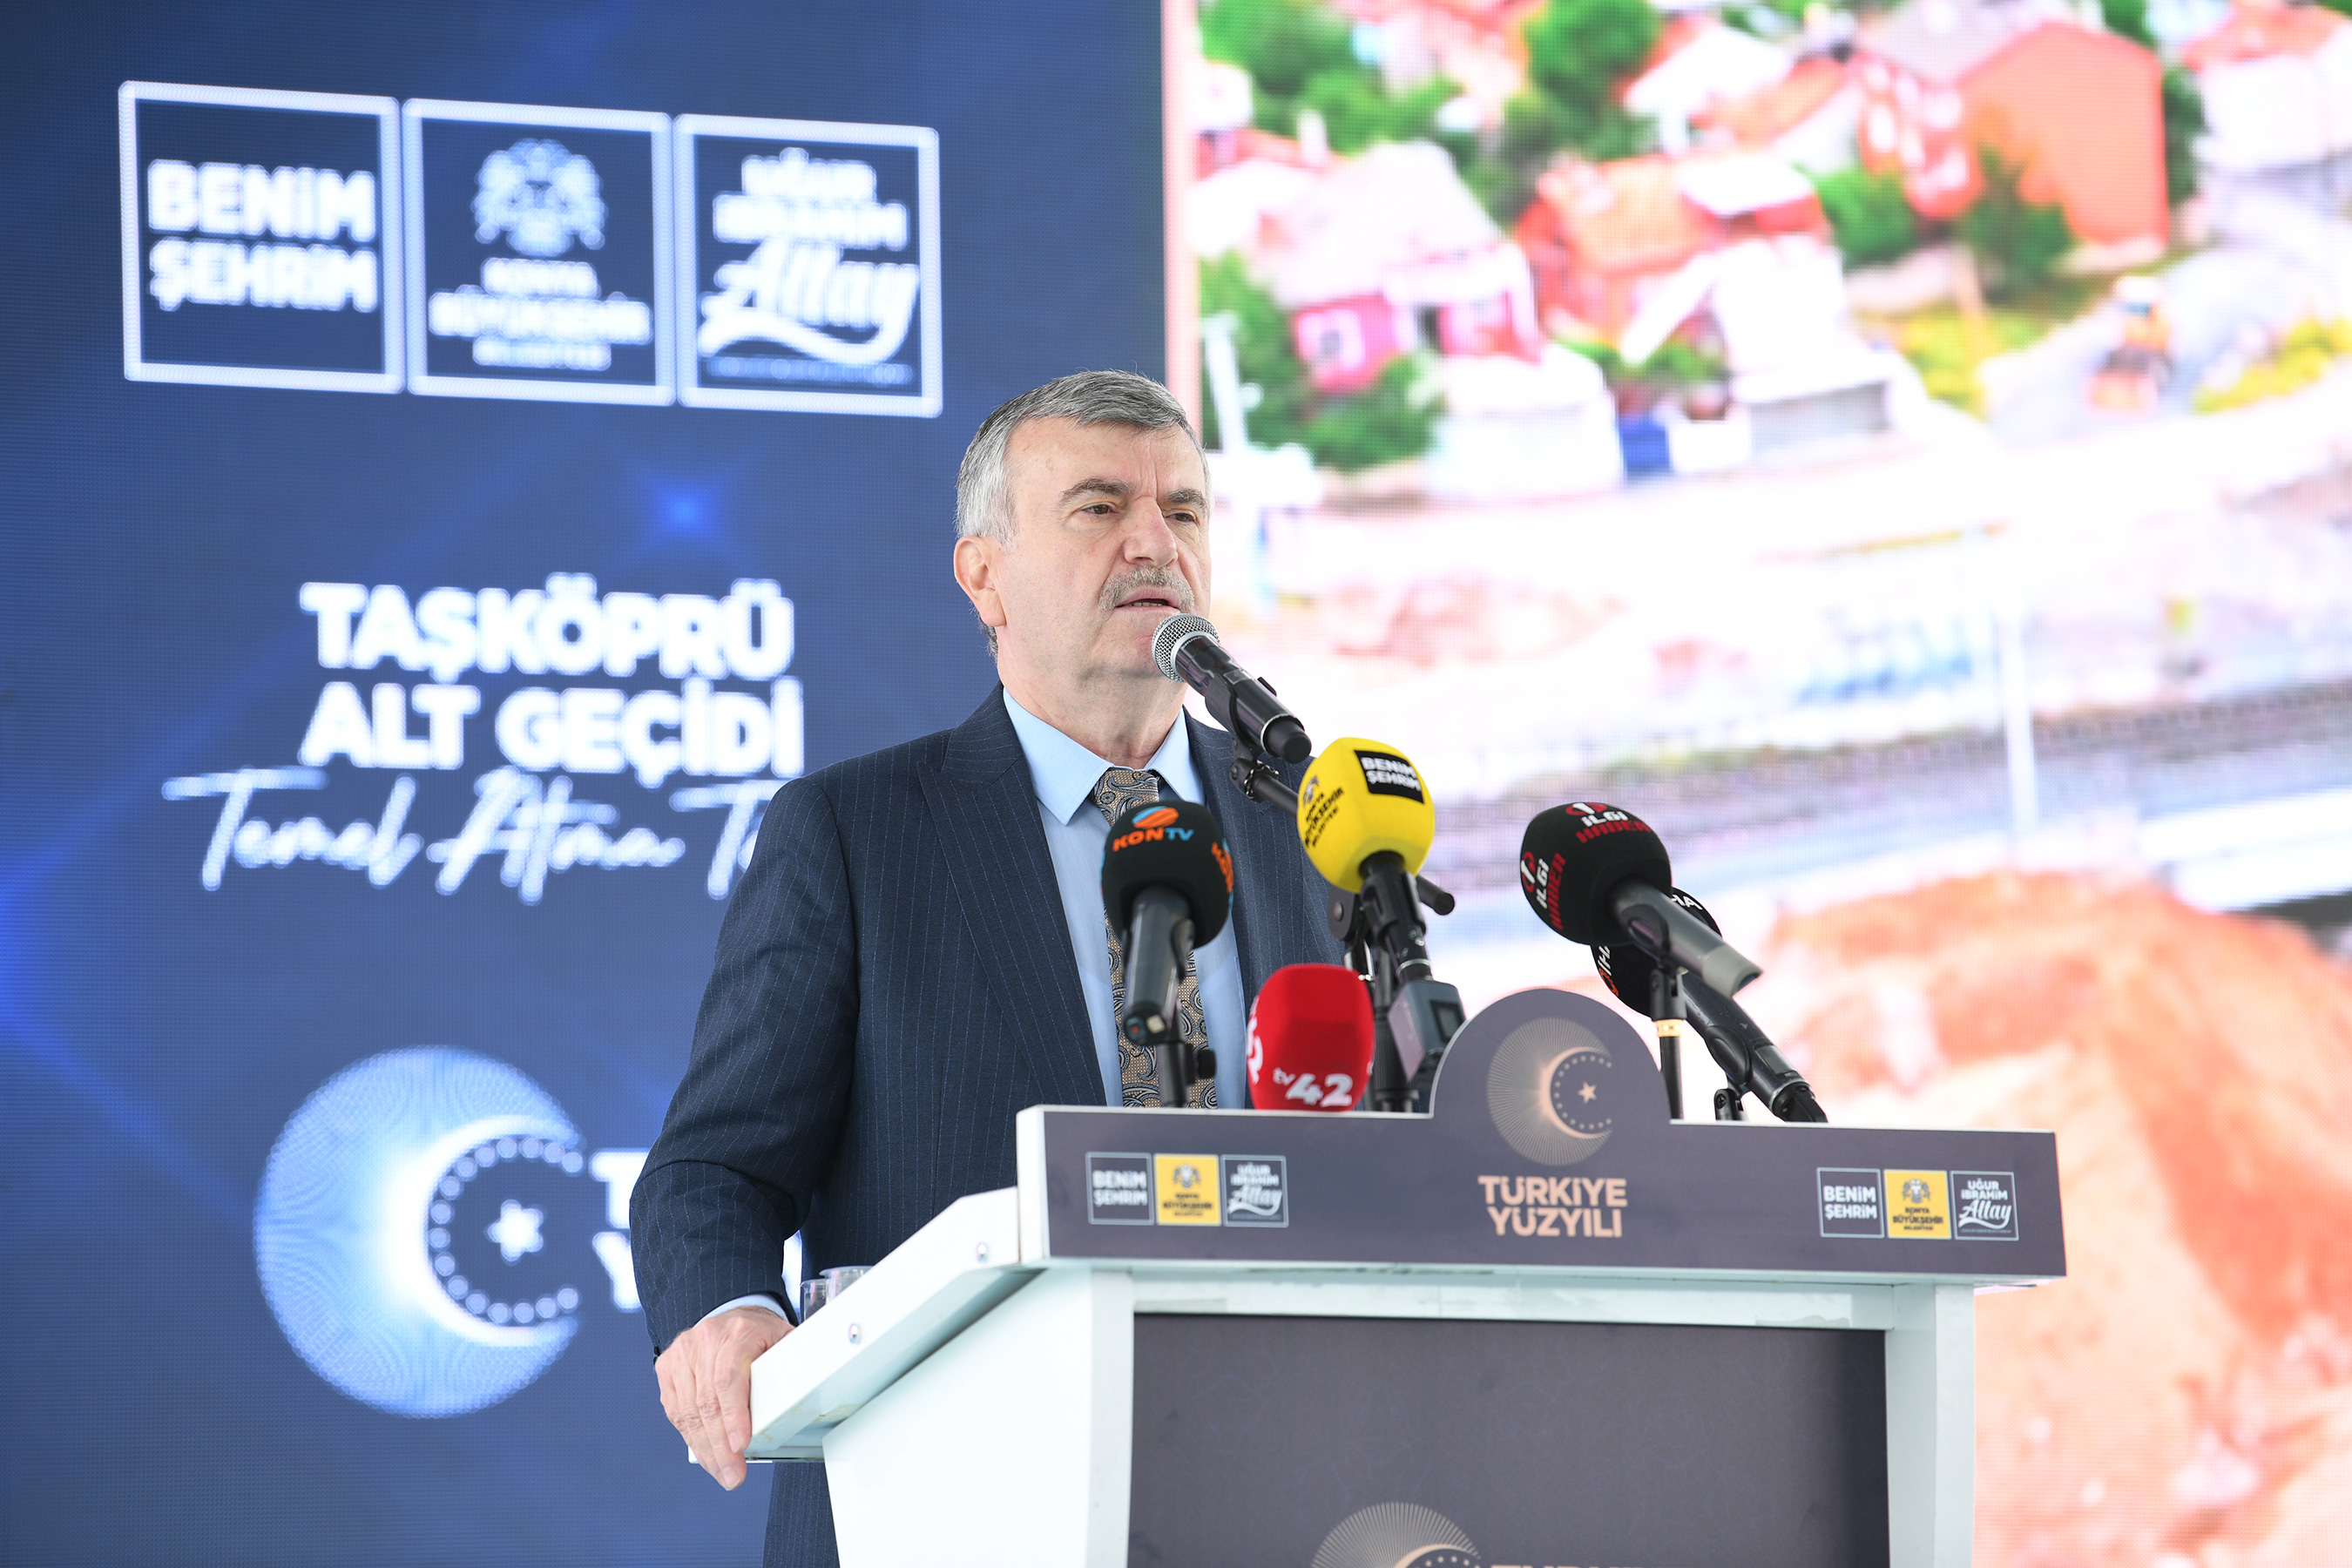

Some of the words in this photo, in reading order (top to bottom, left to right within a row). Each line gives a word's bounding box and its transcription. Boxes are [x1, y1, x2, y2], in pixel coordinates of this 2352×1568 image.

[148, 159, 375, 241] BENİM
[150, 237, 377, 312] ŞEHRİM
[300, 571, 795, 683] TAŞKÖPRÜ
[298, 680, 481, 770] ALT
[495, 676, 805, 788] GEÇİDİ
[162, 766, 423, 892] Temel
[427, 766, 686, 906] Atma
[1477, 1175, 1628, 1207] TÜRKİYE
[1823, 1186, 1877, 1203] BENİM
[1961, 1189, 2008, 1200] İBRAHİM
[1967, 1178, 2000, 1190] UĞUR
[1486, 1206, 1623, 1238] YÜZYILI
[1824, 1204, 1878, 1220] ŞEHRİM
[1958, 1199, 2012, 1229] Altay
